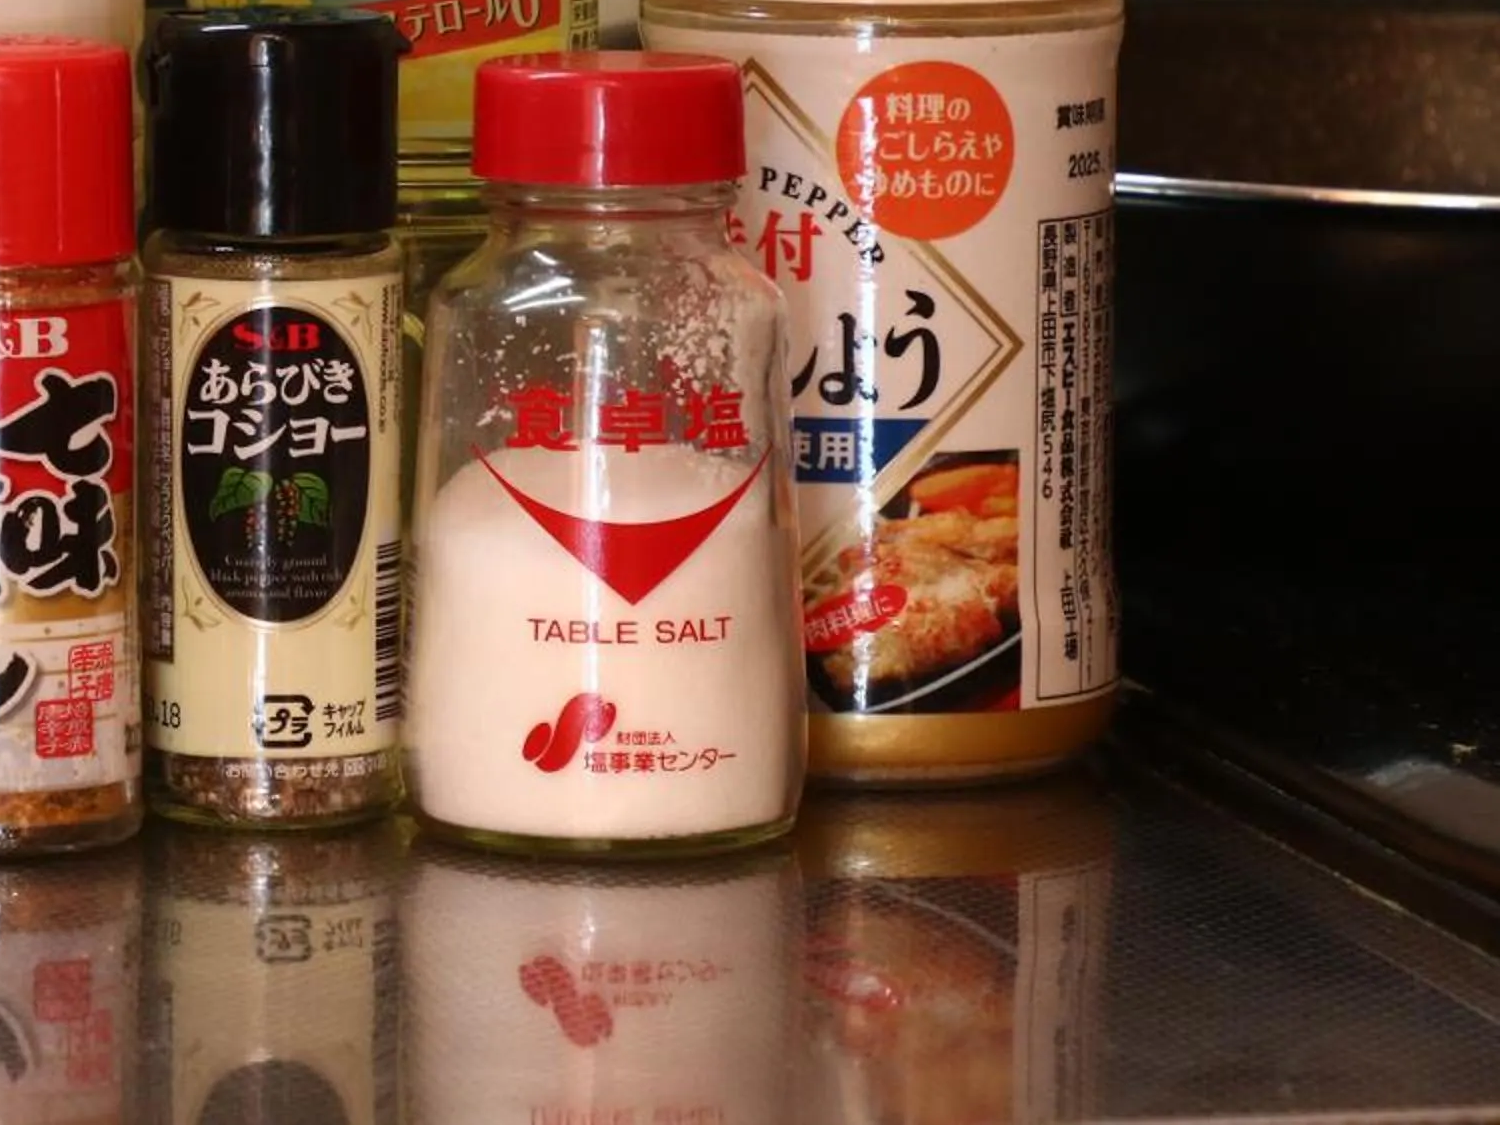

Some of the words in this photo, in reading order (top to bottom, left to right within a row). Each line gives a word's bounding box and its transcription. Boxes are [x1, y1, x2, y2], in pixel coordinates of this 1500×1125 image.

[885, 93, 971, 125] 料理の
[759, 166, 885, 264] PEPPER
[233, 322, 321, 352] S&B
[200, 358, 355, 406] あらびき
[187, 408, 367, 461] コショー
[505, 384, 750, 453] 食卓塩
[528, 617, 639, 645] TABLE
[656, 617, 732, 643] SALT
[616, 730, 677, 746] 財団法人
[584, 748, 737, 774] 塩事業センター
